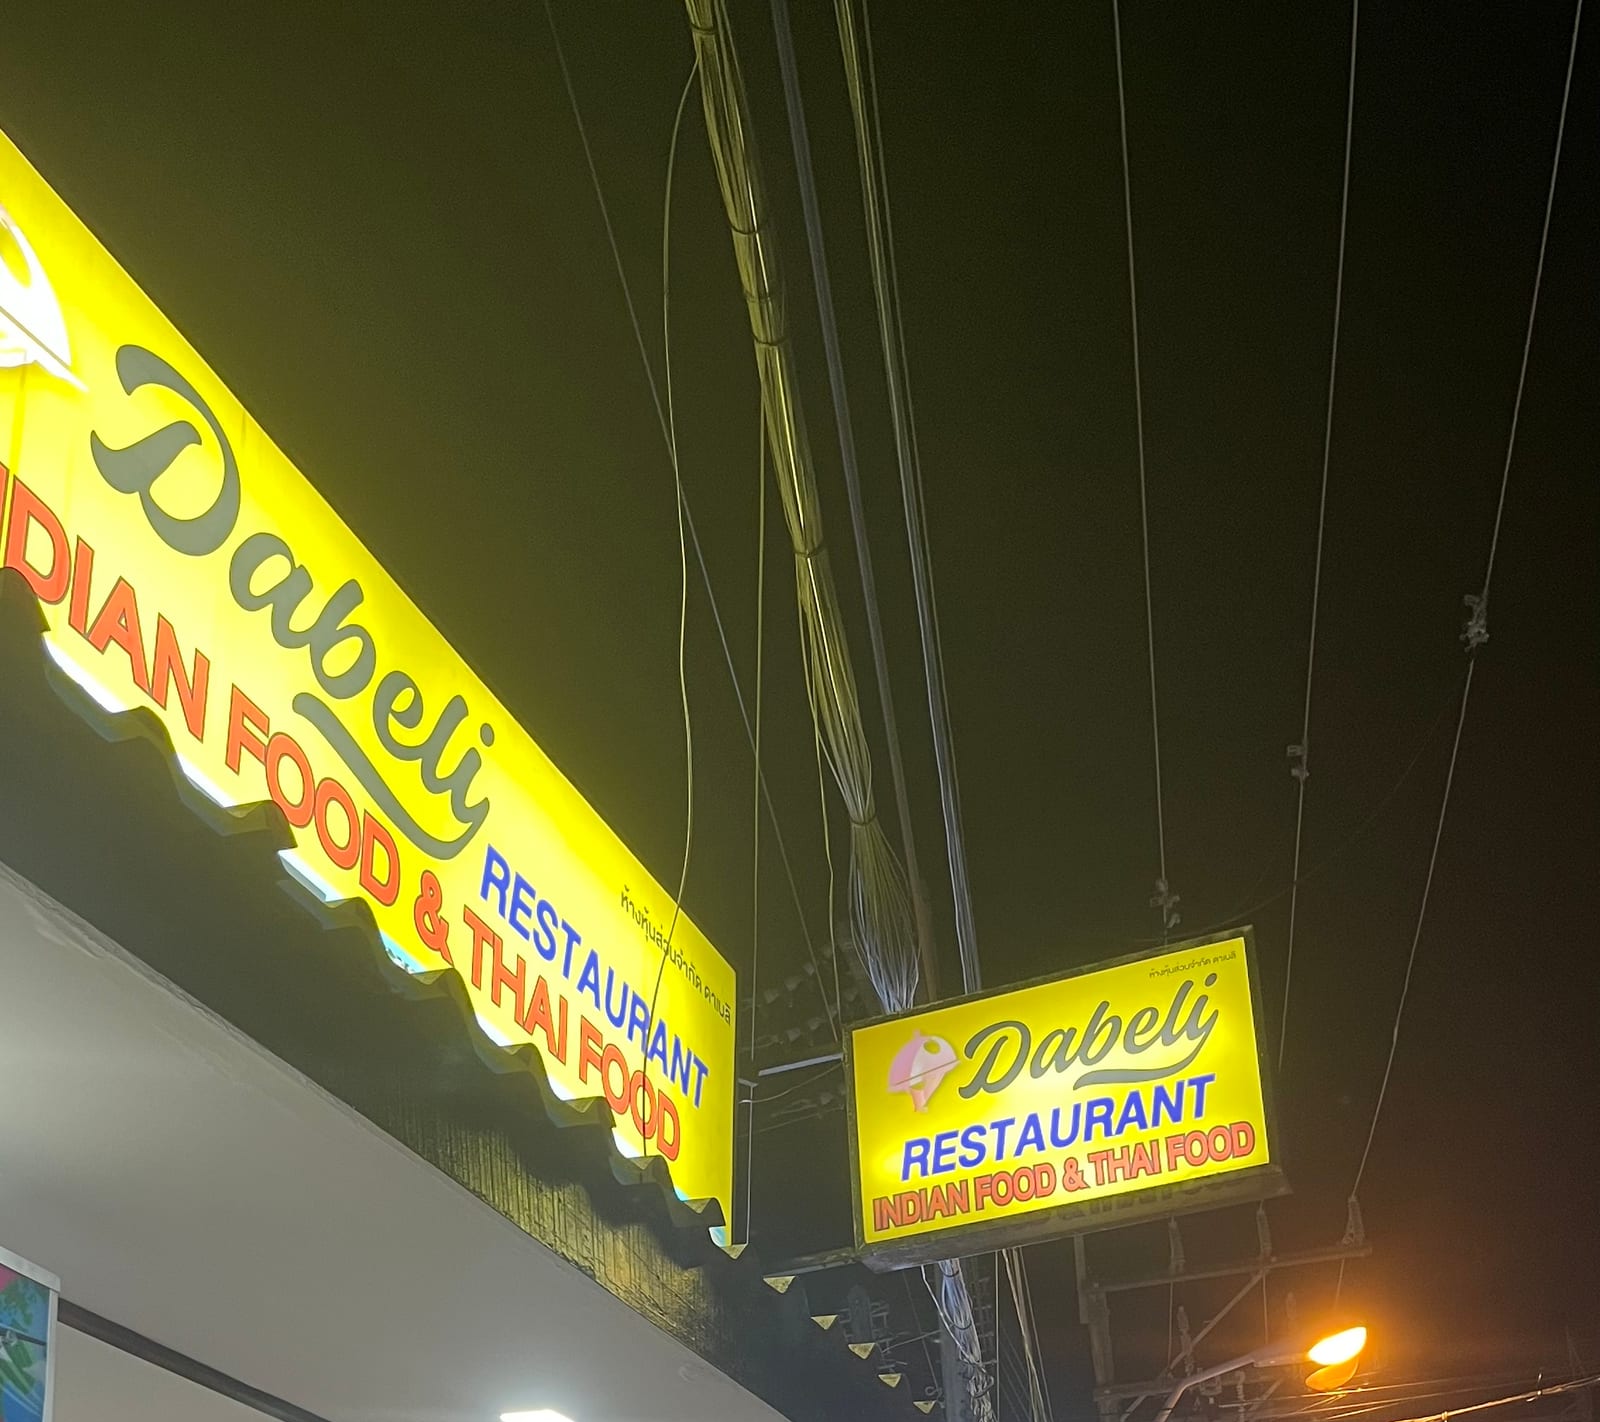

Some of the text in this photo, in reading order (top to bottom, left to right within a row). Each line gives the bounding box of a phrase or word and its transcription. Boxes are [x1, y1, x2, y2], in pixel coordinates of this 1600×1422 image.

[90, 343, 495, 859] Dabeli
[0, 461, 681, 1162] DIAN FOOD & THAI FOOD
[479, 842, 709, 1110] RESTAURANT
[958, 972, 1219, 1099] Dabeli
[873, 1121, 1255, 1232] INDIAN FOOD & THAI FOOD
[901, 1073, 1216, 1182] RESTAURANT
